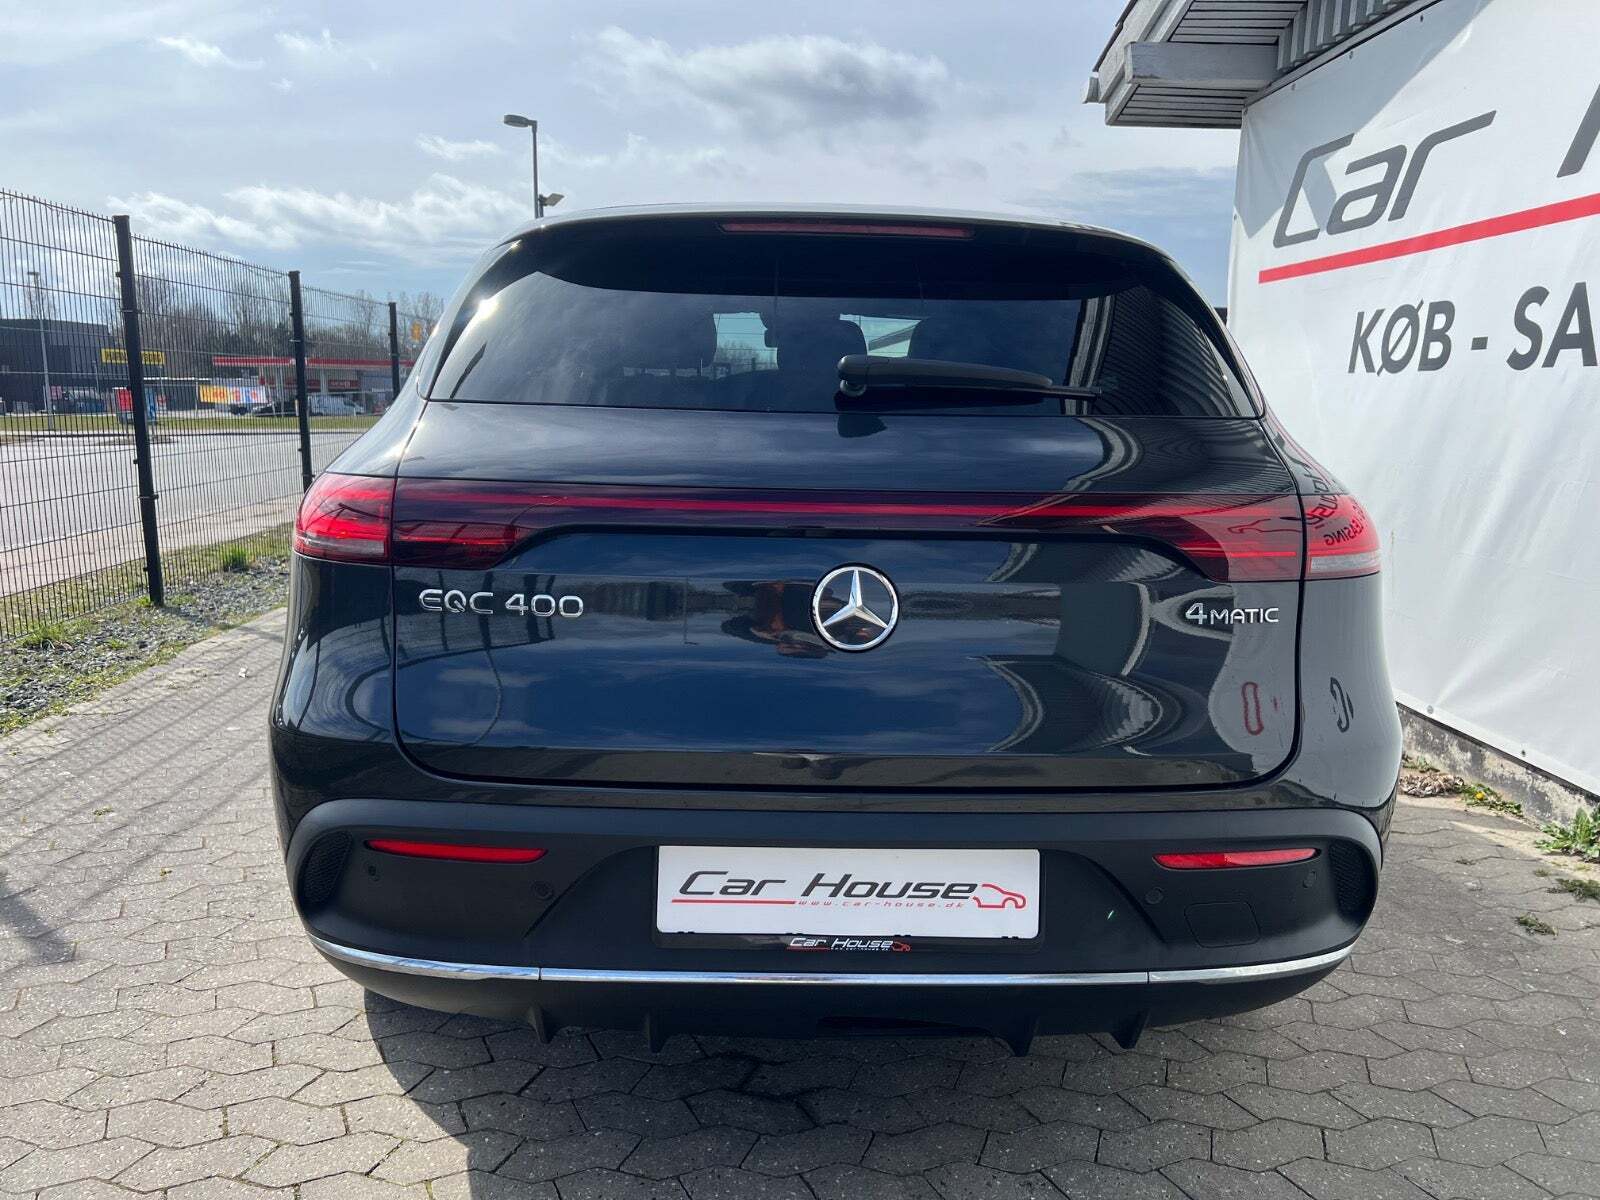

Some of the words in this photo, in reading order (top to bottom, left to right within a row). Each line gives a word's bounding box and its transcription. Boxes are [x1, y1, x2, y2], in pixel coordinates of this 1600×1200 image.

[1273, 110, 1497, 248] Car
[1348, 299, 1456, 376] KØB
[1506, 281, 1599, 371] SA
[418, 588, 494, 614] EQC
[504, 593, 584, 618] 400
[1185, 602, 1280, 625] 4MATIC
[678, 870, 787, 897] Car
[800, 872, 979, 900] House
[798, 900, 966, 909] www.car-house.dk
[789, 937, 828, 947] Car
[831, 937, 894, 949] House
